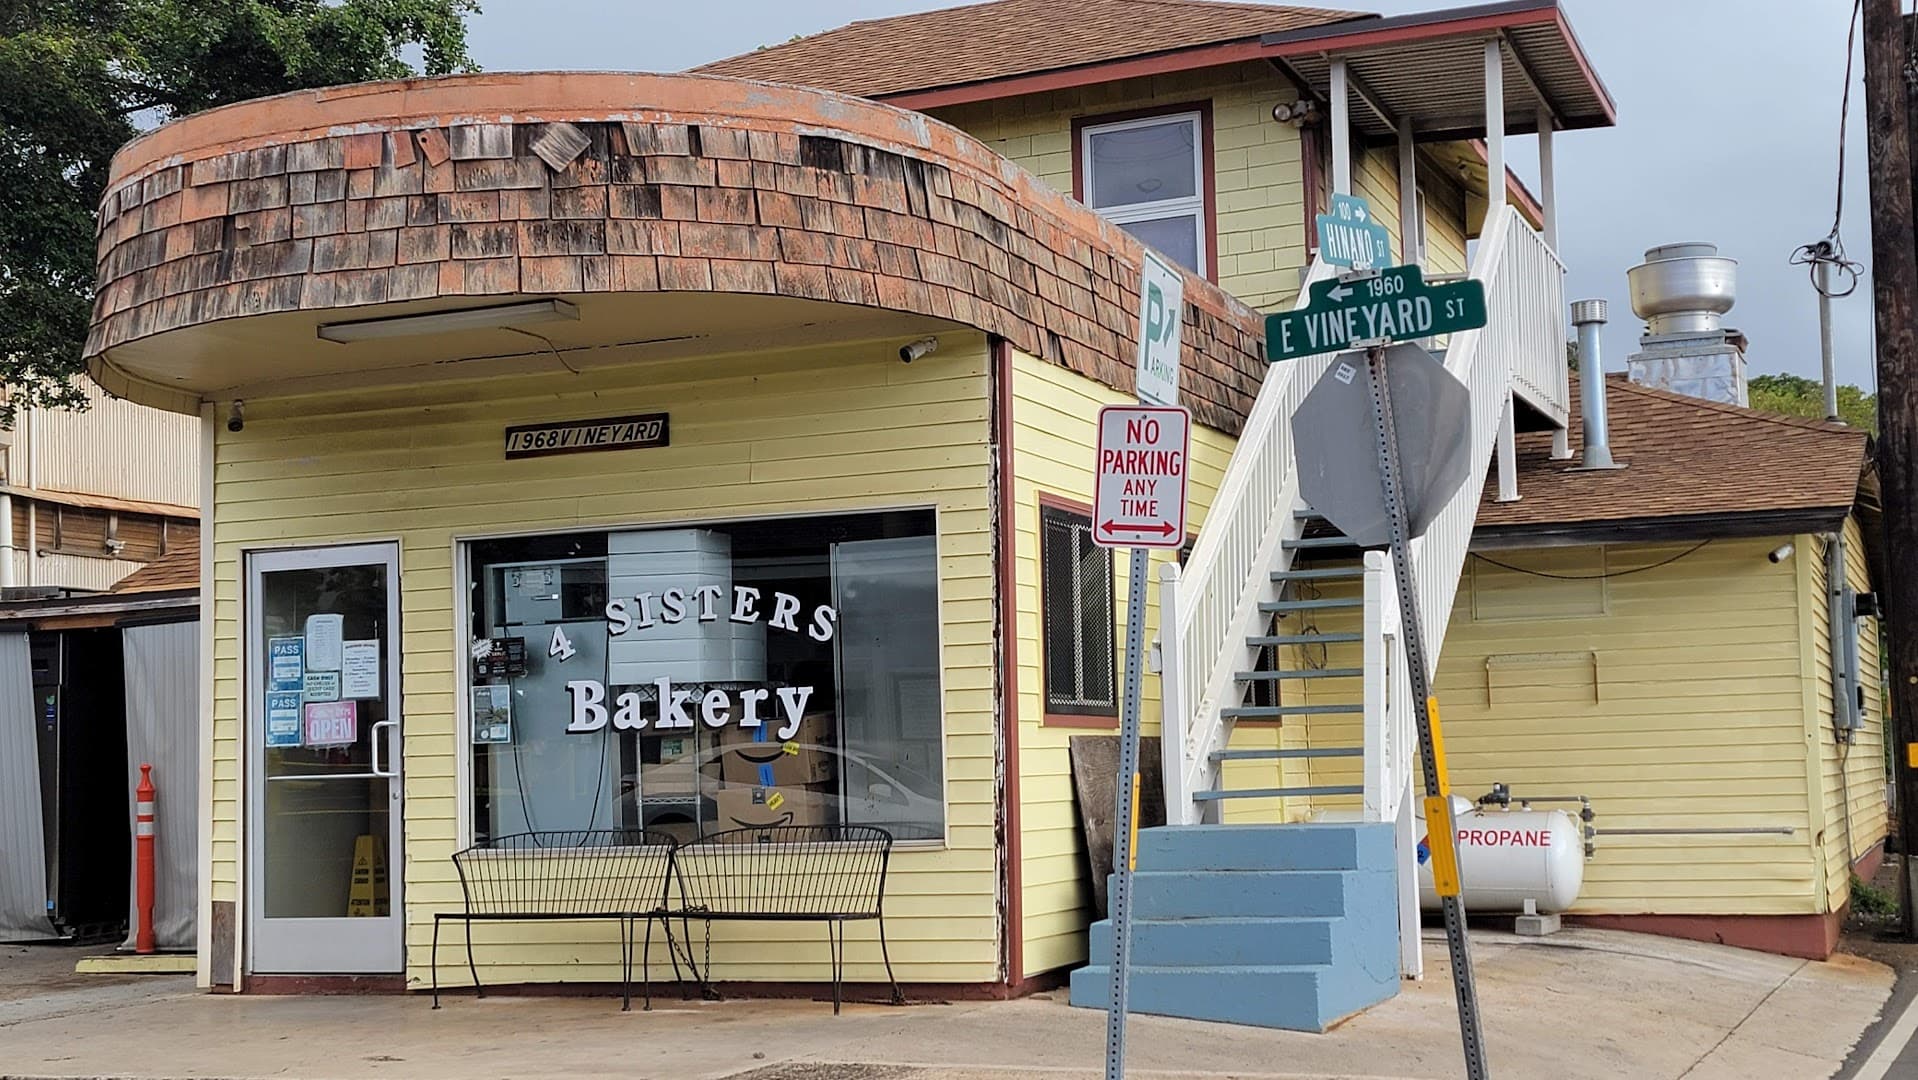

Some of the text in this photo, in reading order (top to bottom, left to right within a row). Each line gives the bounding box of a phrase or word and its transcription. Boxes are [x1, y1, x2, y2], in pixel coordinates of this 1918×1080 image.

[1338, 202, 1352, 221] 100
[1326, 223, 1385, 264] HINANO ST
[1366, 275, 1404, 298] 1960
[1281, 295, 1465, 353] E VINEYARD ST
[1127, 419, 1160, 444] NO
[1102, 449, 1181, 476] PARKING
[1123, 479, 1158, 496] ANY
[1120, 499, 1159, 517] TIME
[549, 585, 838, 661] 4 SISTERS
[274, 645, 299, 655] PASS
[271, 699, 296, 709] PASS
[567, 676, 814, 740] Bakery
[310, 718, 352, 741] OPEN
[1458, 830, 1552, 846] PROPANE
